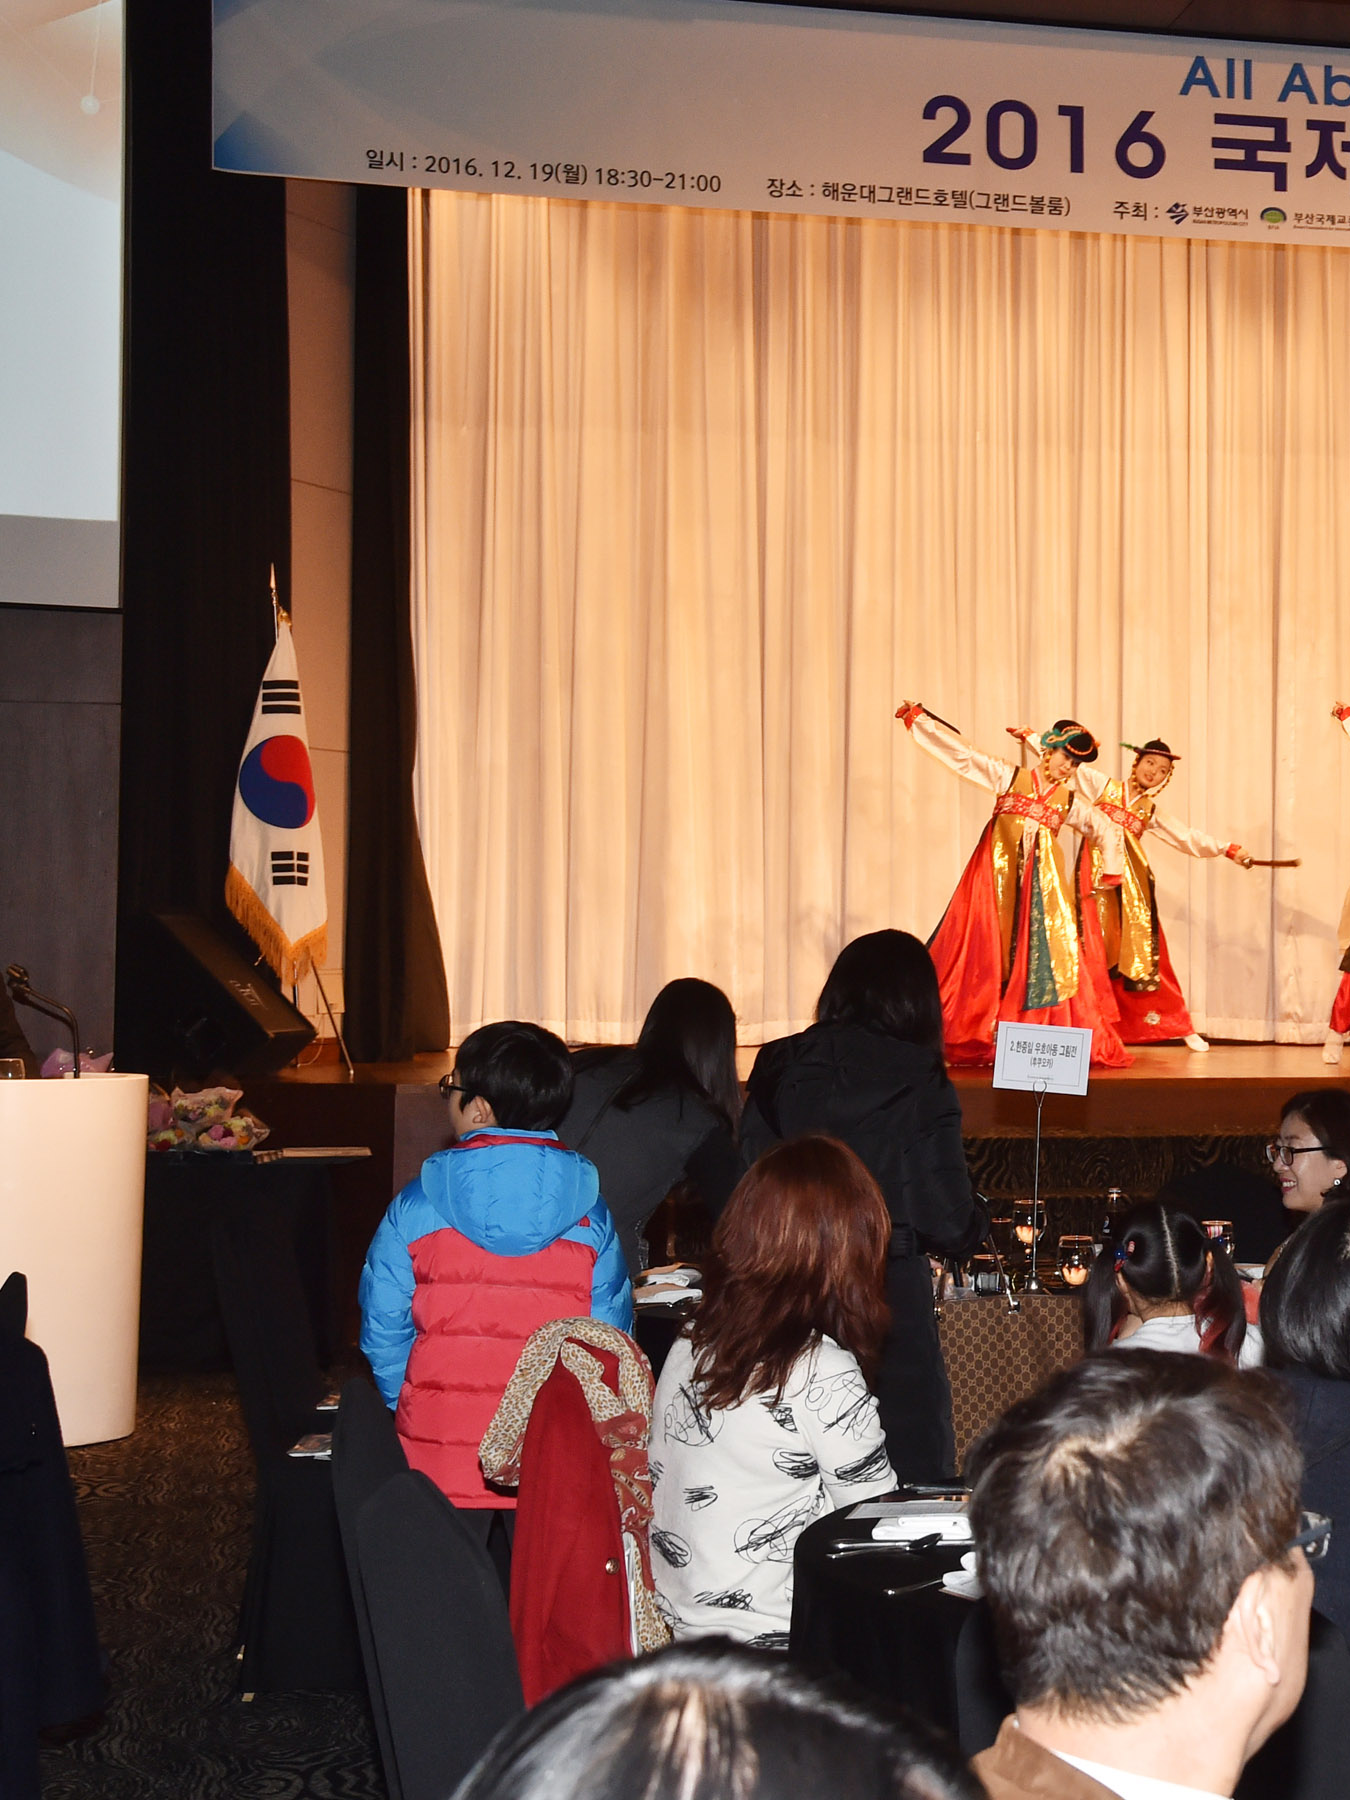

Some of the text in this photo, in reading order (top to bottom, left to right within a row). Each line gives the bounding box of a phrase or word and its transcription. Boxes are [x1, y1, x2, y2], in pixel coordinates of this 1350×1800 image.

[1180, 55, 1254, 100] All
[922, 94, 1166, 181] 2016
[366, 149, 404, 172] 일시
[425, 154, 483, 178] 2016.
[491, 160, 522, 180] 12.
[530, 162, 588, 186] 19(월)
[596, 167, 722, 193] 18:30-21:00
[767, 178, 803, 199] 장소
[822, 181, 1071, 218] 해운대그랜드호텔(그랜드볼룸)
[1113, 200, 1148, 221] 주최
[1193, 206, 1249, 220] 부산광역시
